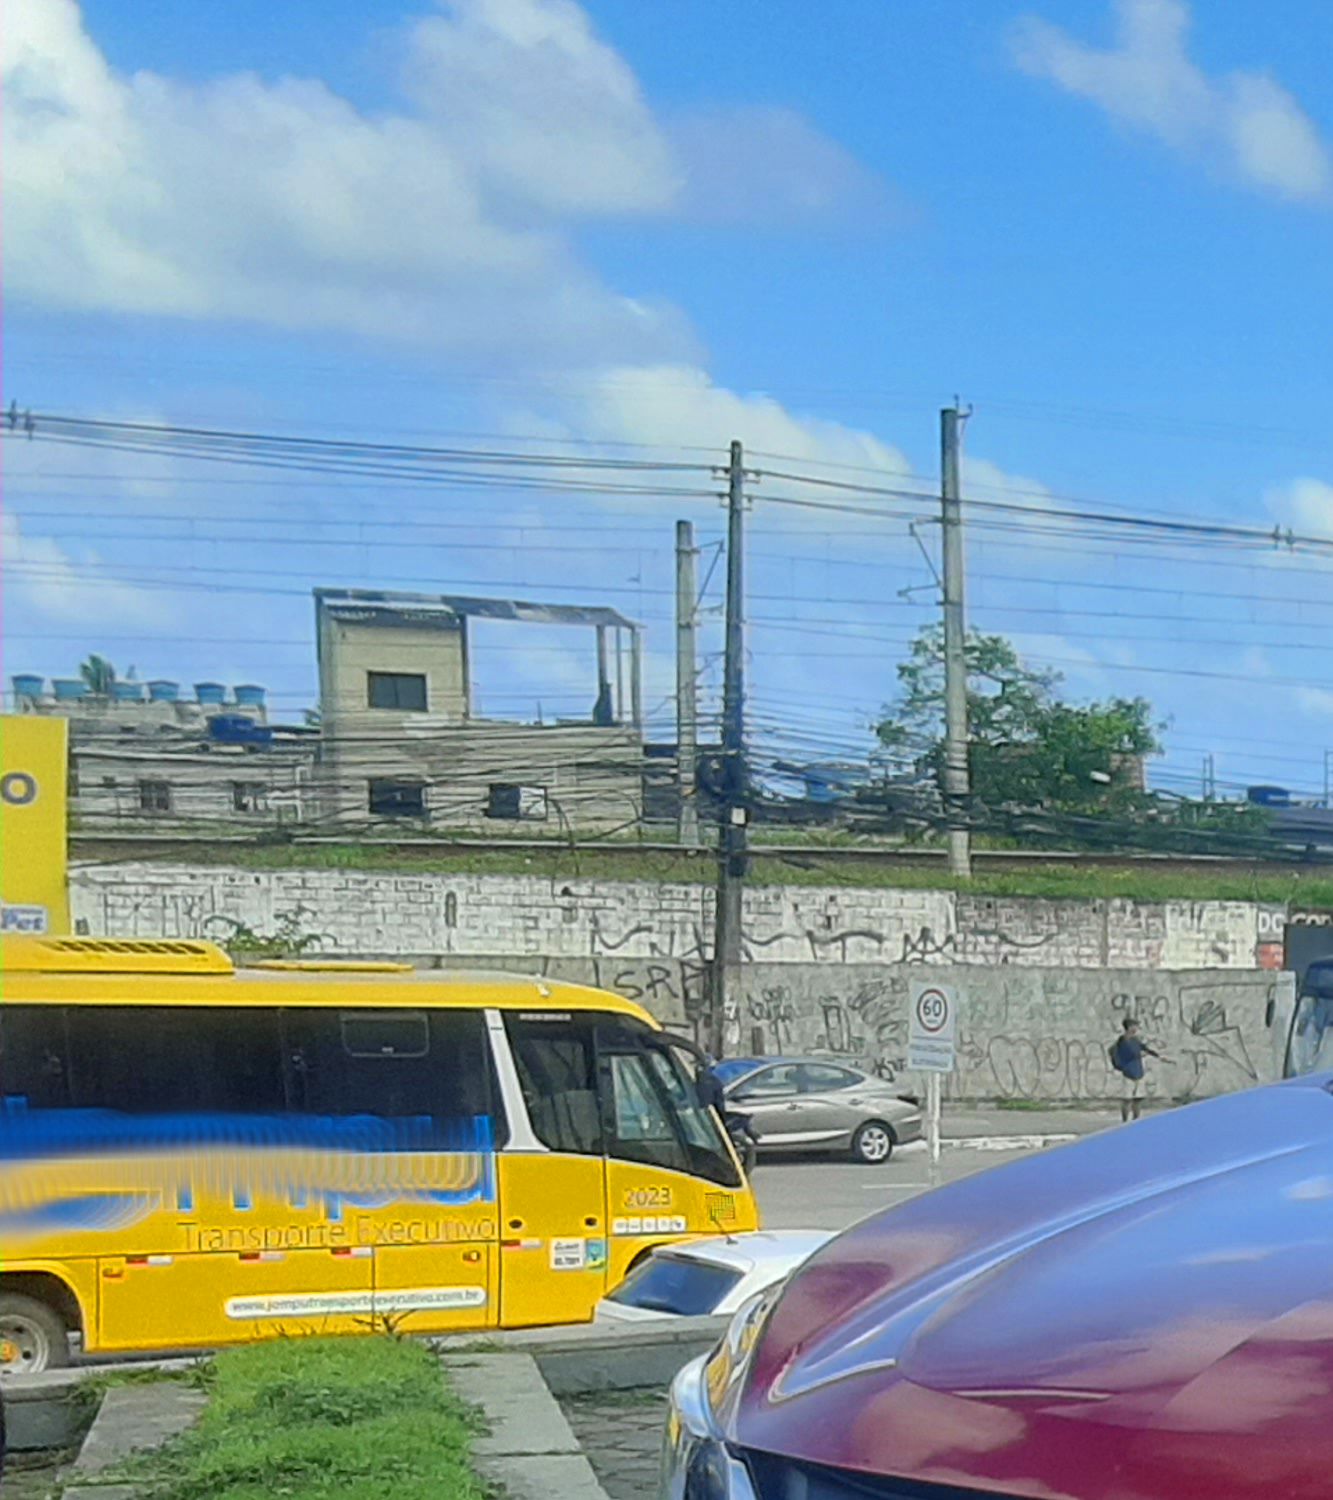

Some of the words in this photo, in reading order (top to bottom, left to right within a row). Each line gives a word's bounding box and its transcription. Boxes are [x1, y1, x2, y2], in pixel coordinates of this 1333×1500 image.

[923, 999, 942, 1017] 60
[624, 1187, 671, 1208] 2023
[176, 1222, 345, 1251] Transporte
[357, 1214, 495, 1243] Executivo
